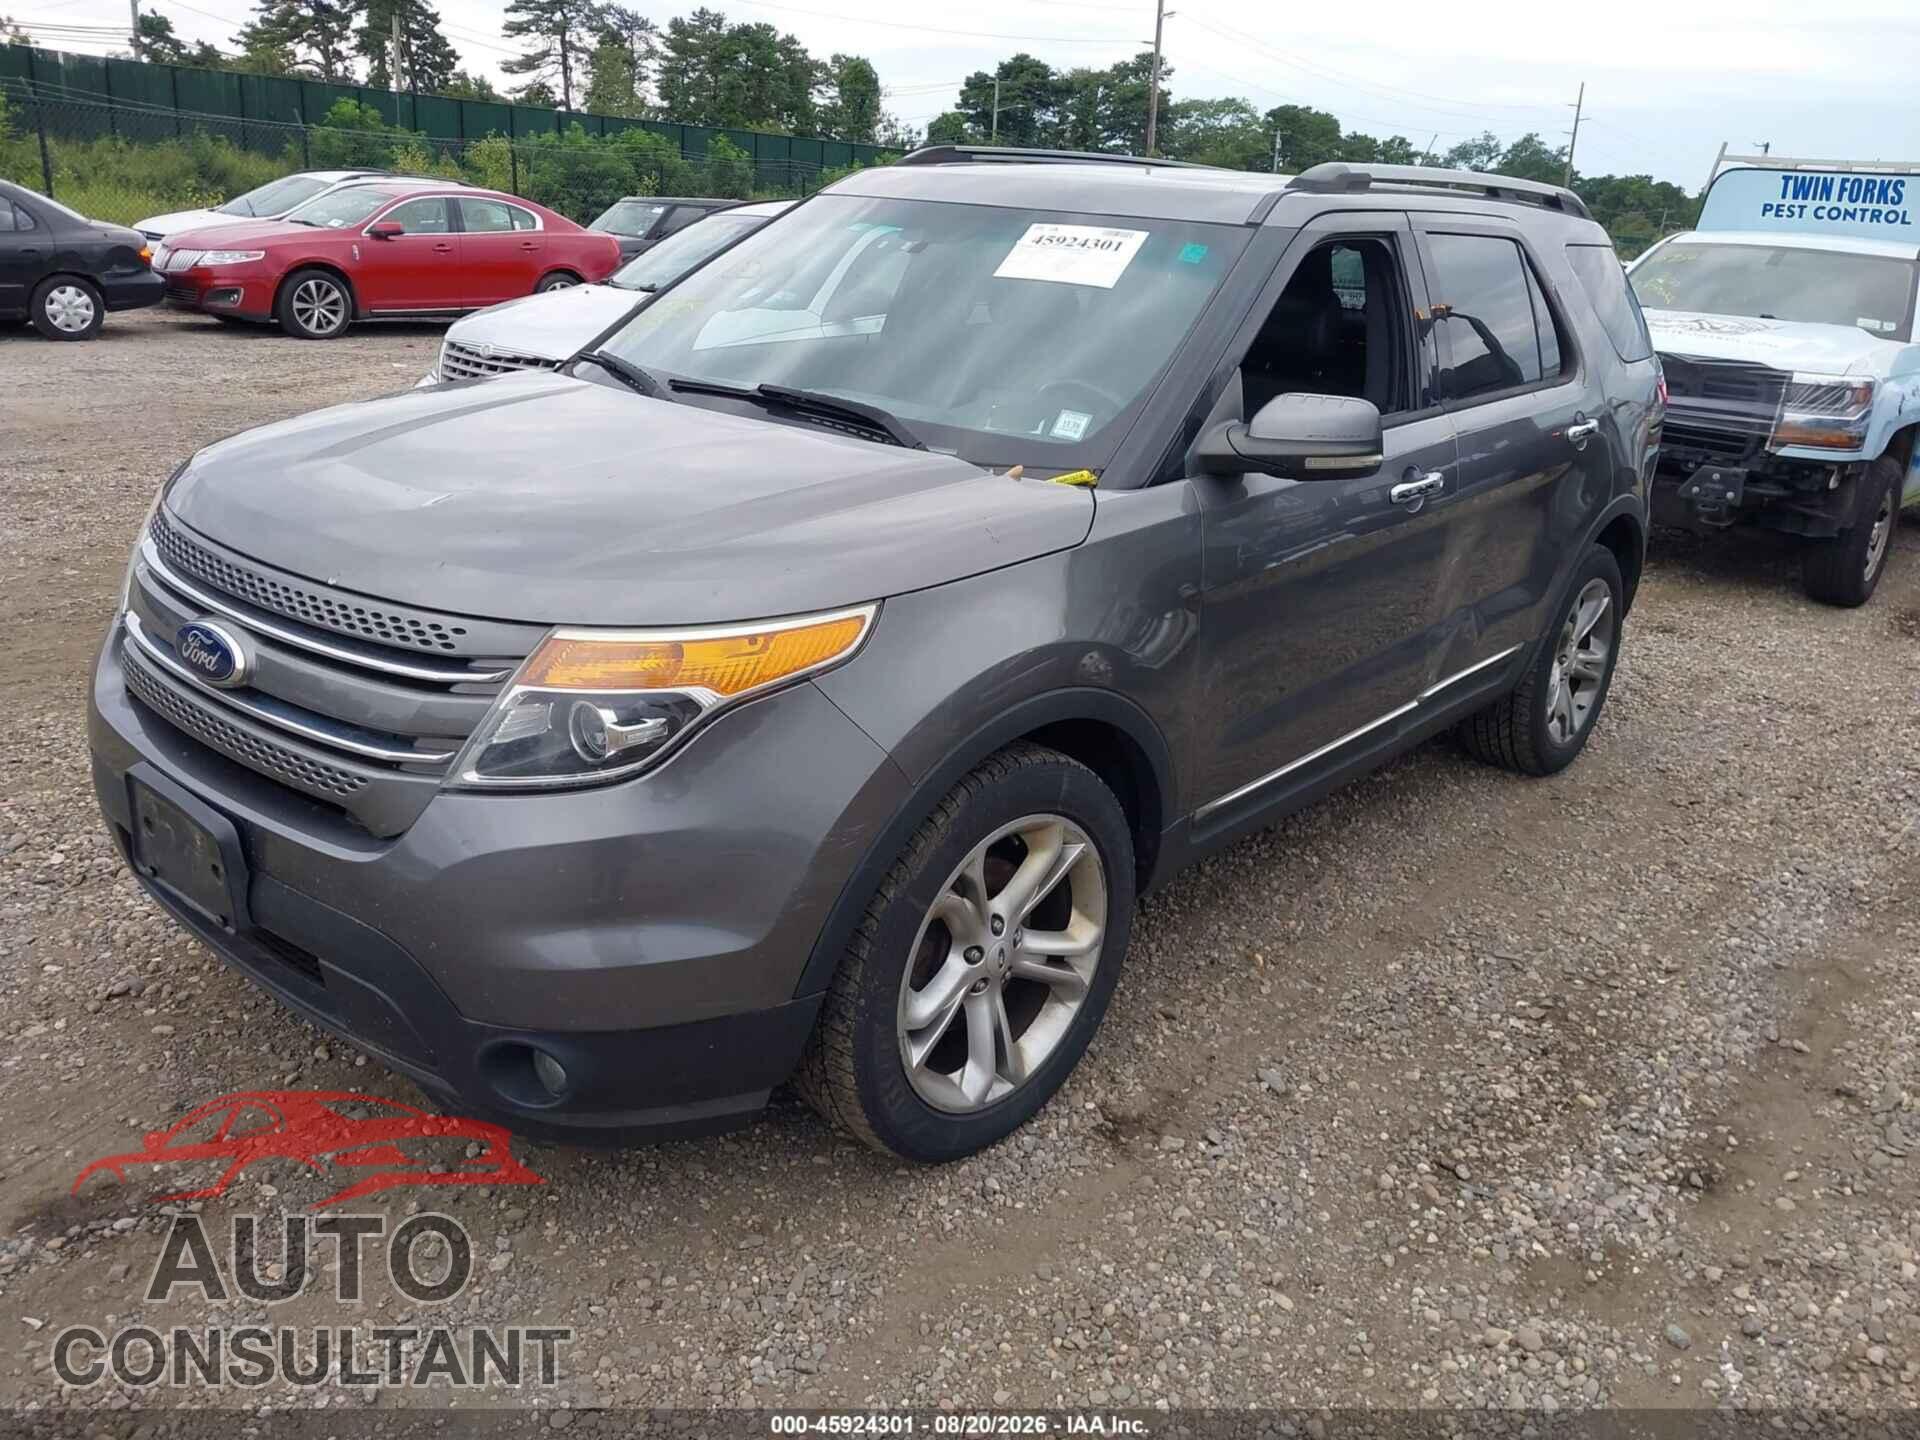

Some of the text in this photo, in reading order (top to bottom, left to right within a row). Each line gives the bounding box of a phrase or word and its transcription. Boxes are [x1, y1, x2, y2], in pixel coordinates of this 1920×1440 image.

[1781, 175, 1905, 206] TWIN FORKS
[1761, 203, 1912, 225] PEST CONTROL
[1032, 234, 1123, 252] 45924301
[182, 630, 221, 671] Ford
